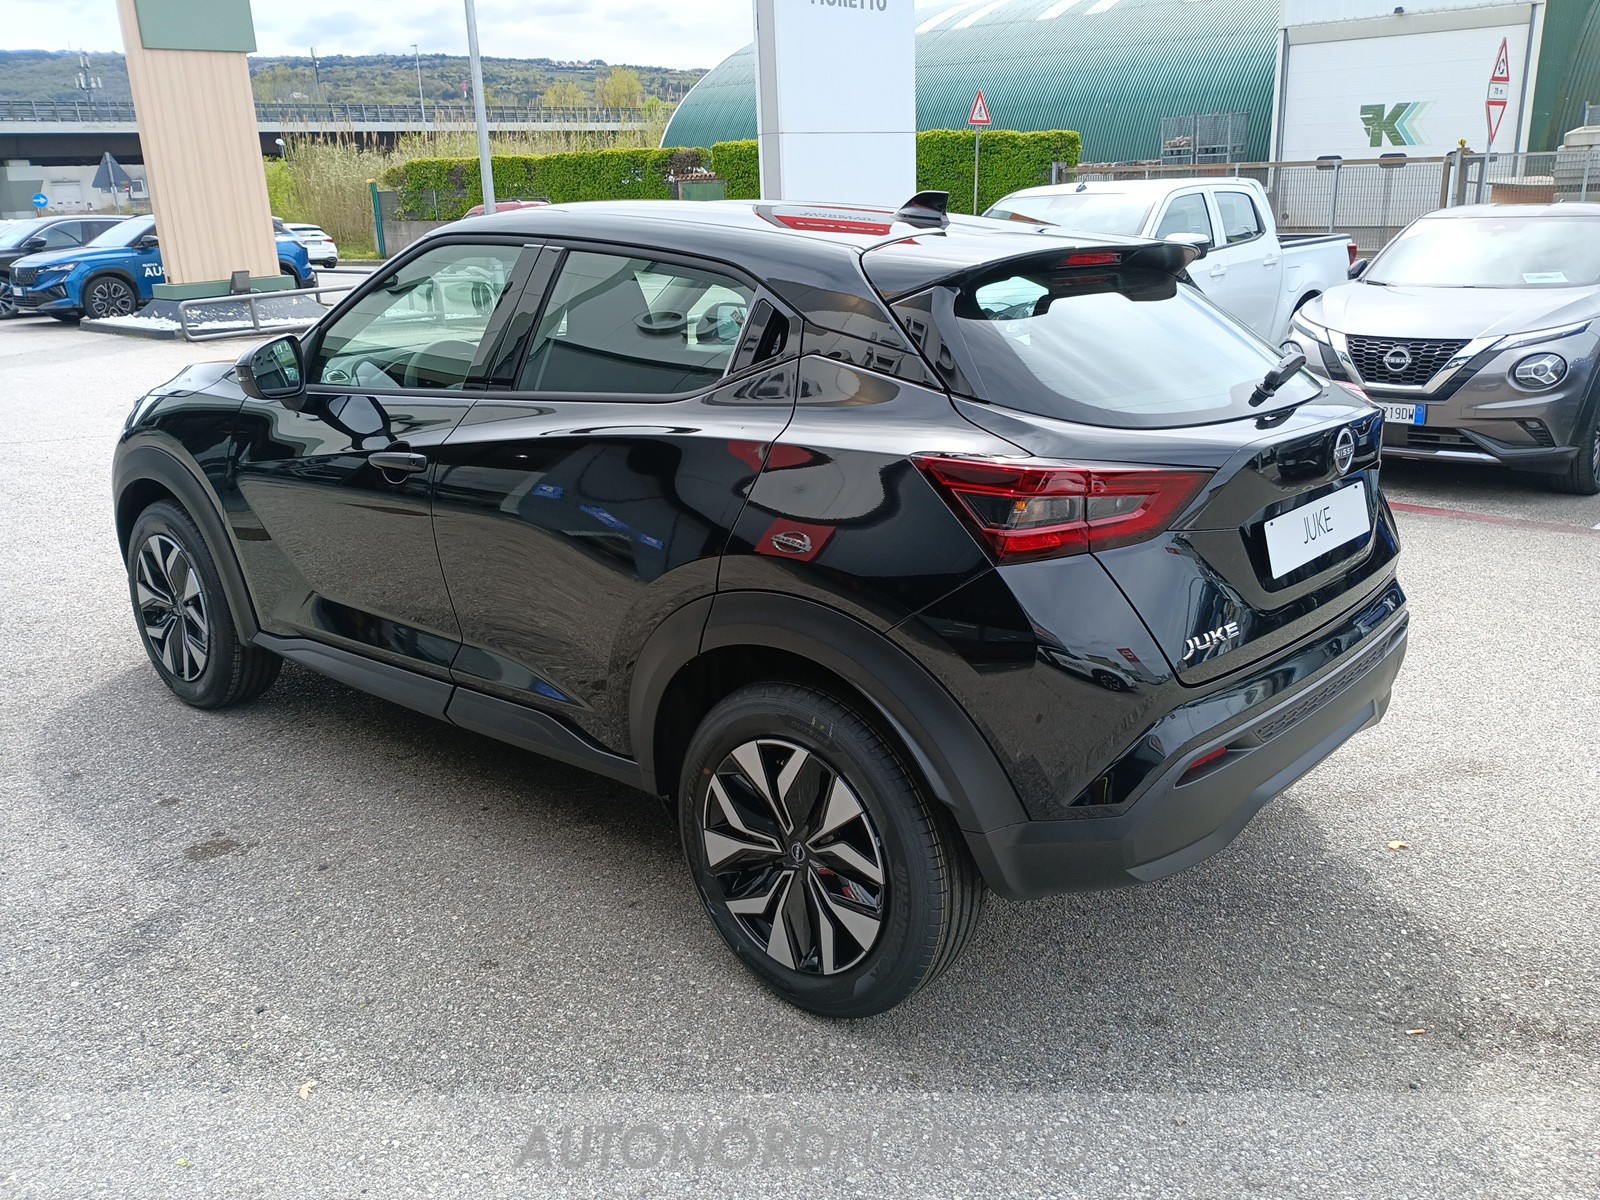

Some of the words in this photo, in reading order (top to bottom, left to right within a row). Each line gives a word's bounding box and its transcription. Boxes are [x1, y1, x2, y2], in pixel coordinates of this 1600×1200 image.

[1383, 356, 1412, 364] NISSAN
[1303, 506, 1334, 545] JUKE
[1182, 621, 1240, 661] JUKE
